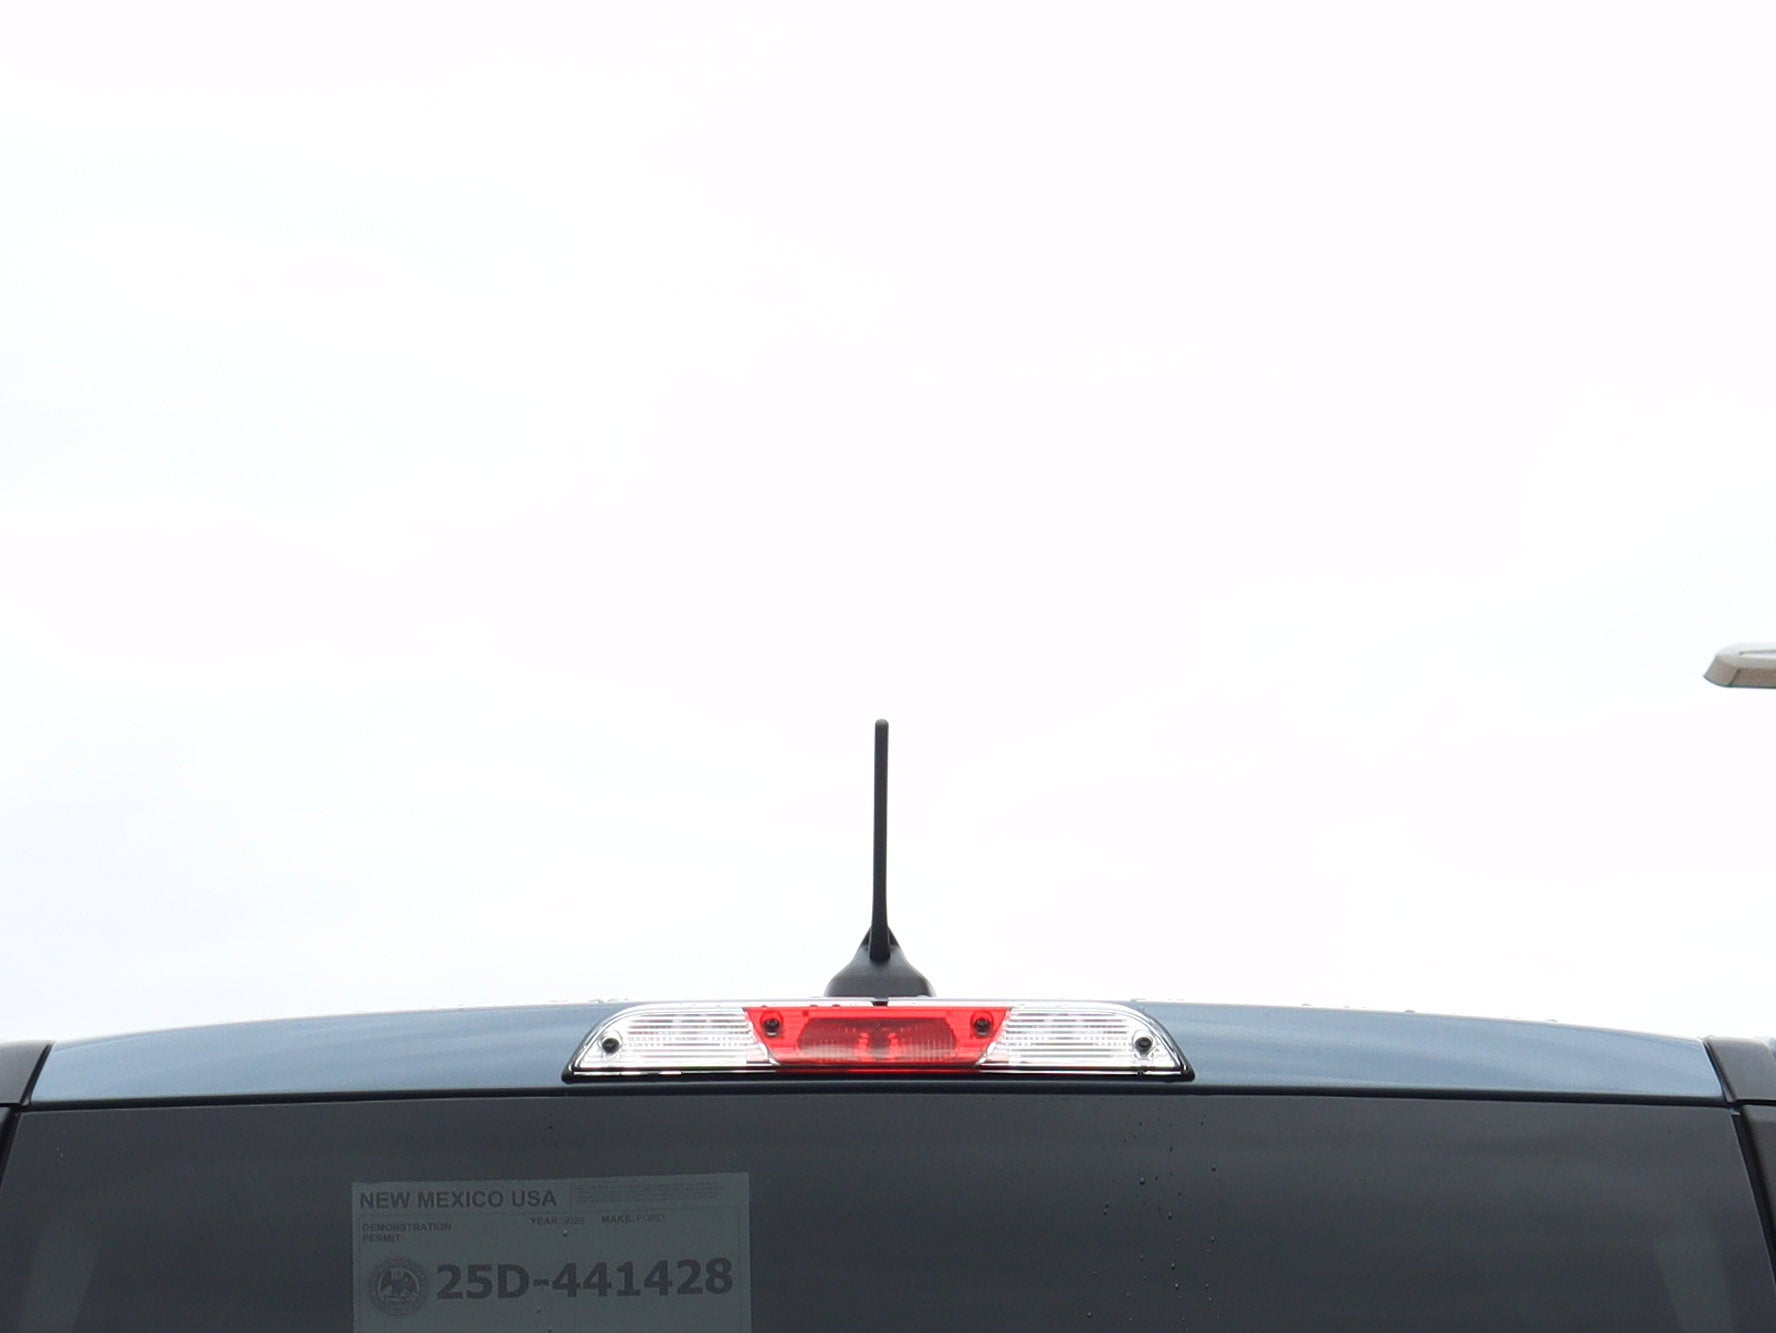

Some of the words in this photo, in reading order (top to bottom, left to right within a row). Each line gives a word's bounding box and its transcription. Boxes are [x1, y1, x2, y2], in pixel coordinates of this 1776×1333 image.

[360, 1191, 411, 1209] NEW
[417, 1190, 504, 1208] MEXICO
[511, 1189, 557, 1207] USA
[636, 1212, 665, 1223] FORD
[362, 1222, 452, 1232] DEMONSTRATION
[362, 1234, 400, 1243] PERMIT
[436, 1257, 734, 1300] 25D-441428
